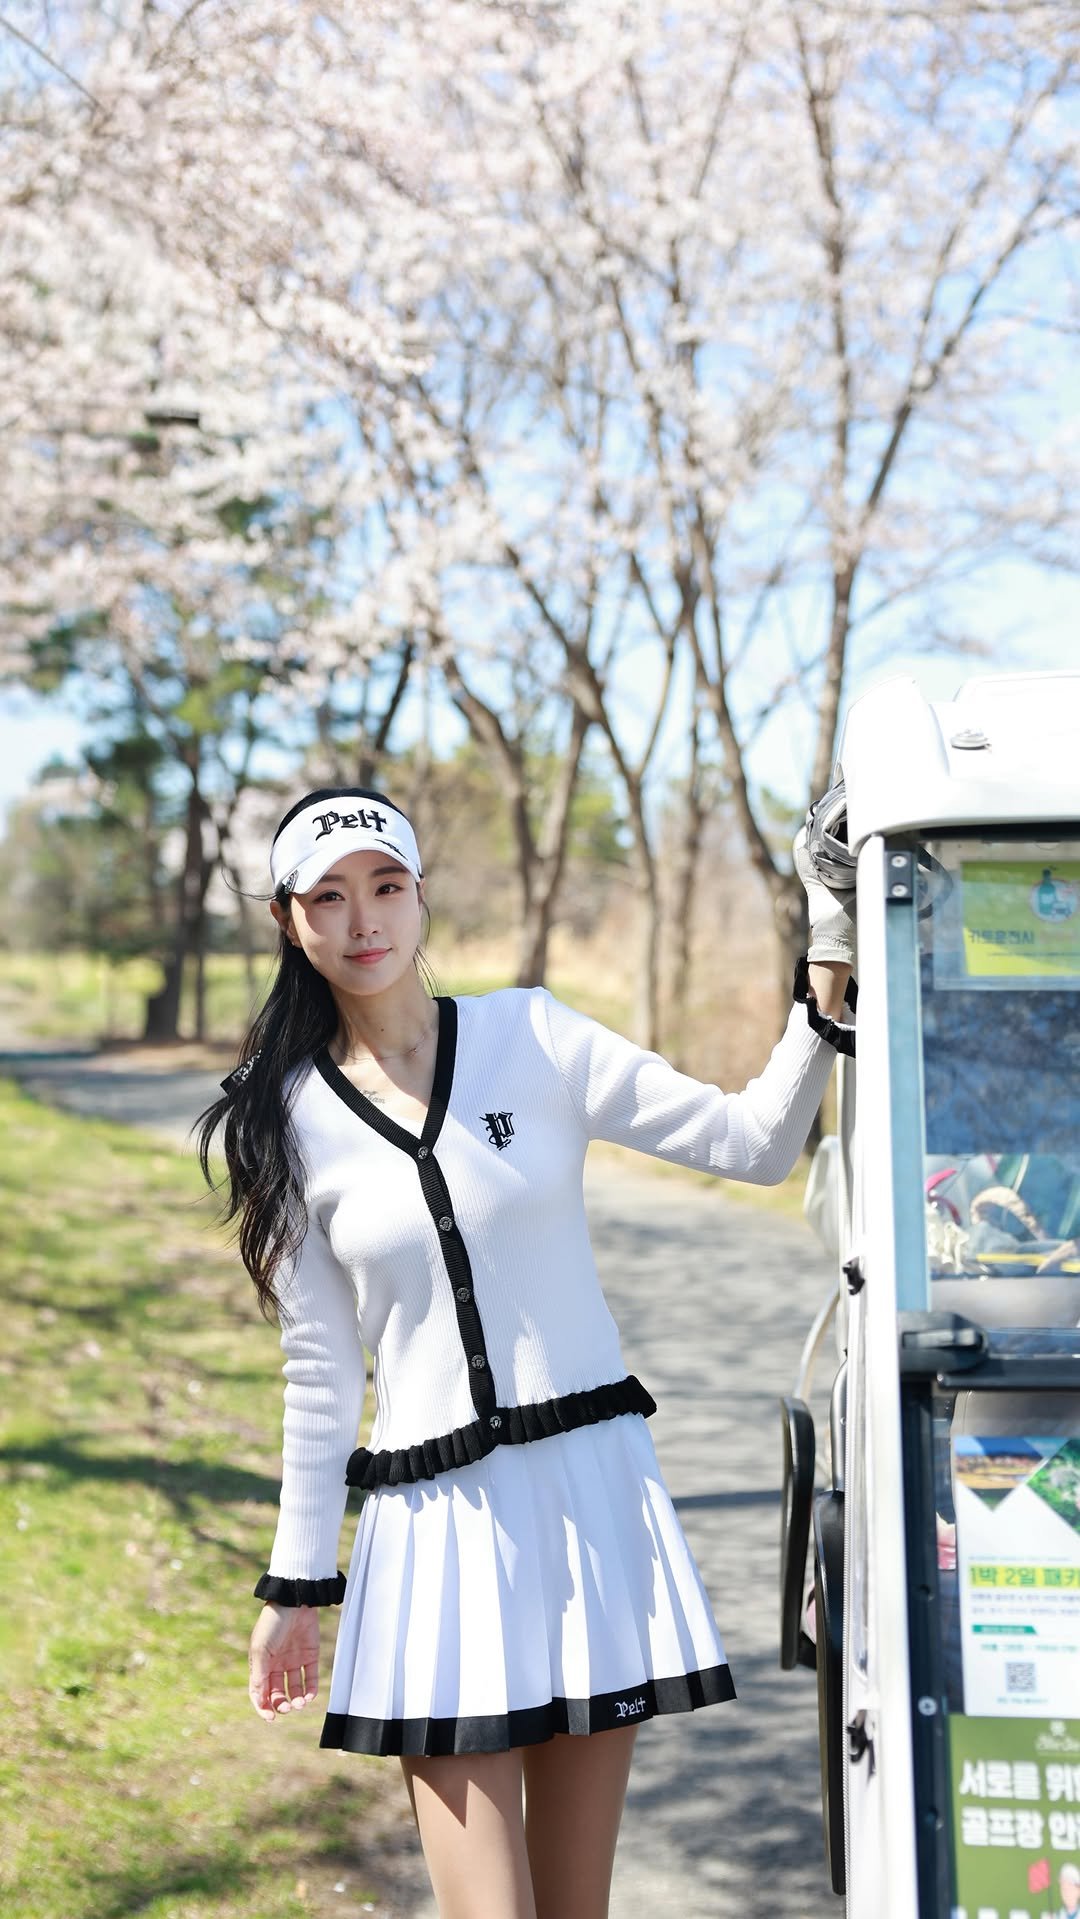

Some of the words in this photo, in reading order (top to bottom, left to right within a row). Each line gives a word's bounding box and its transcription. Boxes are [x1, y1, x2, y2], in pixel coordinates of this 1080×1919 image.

[312, 809, 388, 841] Pelt
[971, 1566, 996, 1586] 1박
[1006, 1566, 1036, 1587] 2일
[614, 1697, 646, 1718] Pelt
[959, 1758, 1041, 1800] 서로를
[961, 1804, 1044, 1849] 골프장
[1048, 1809, 1080, 1851] 안
